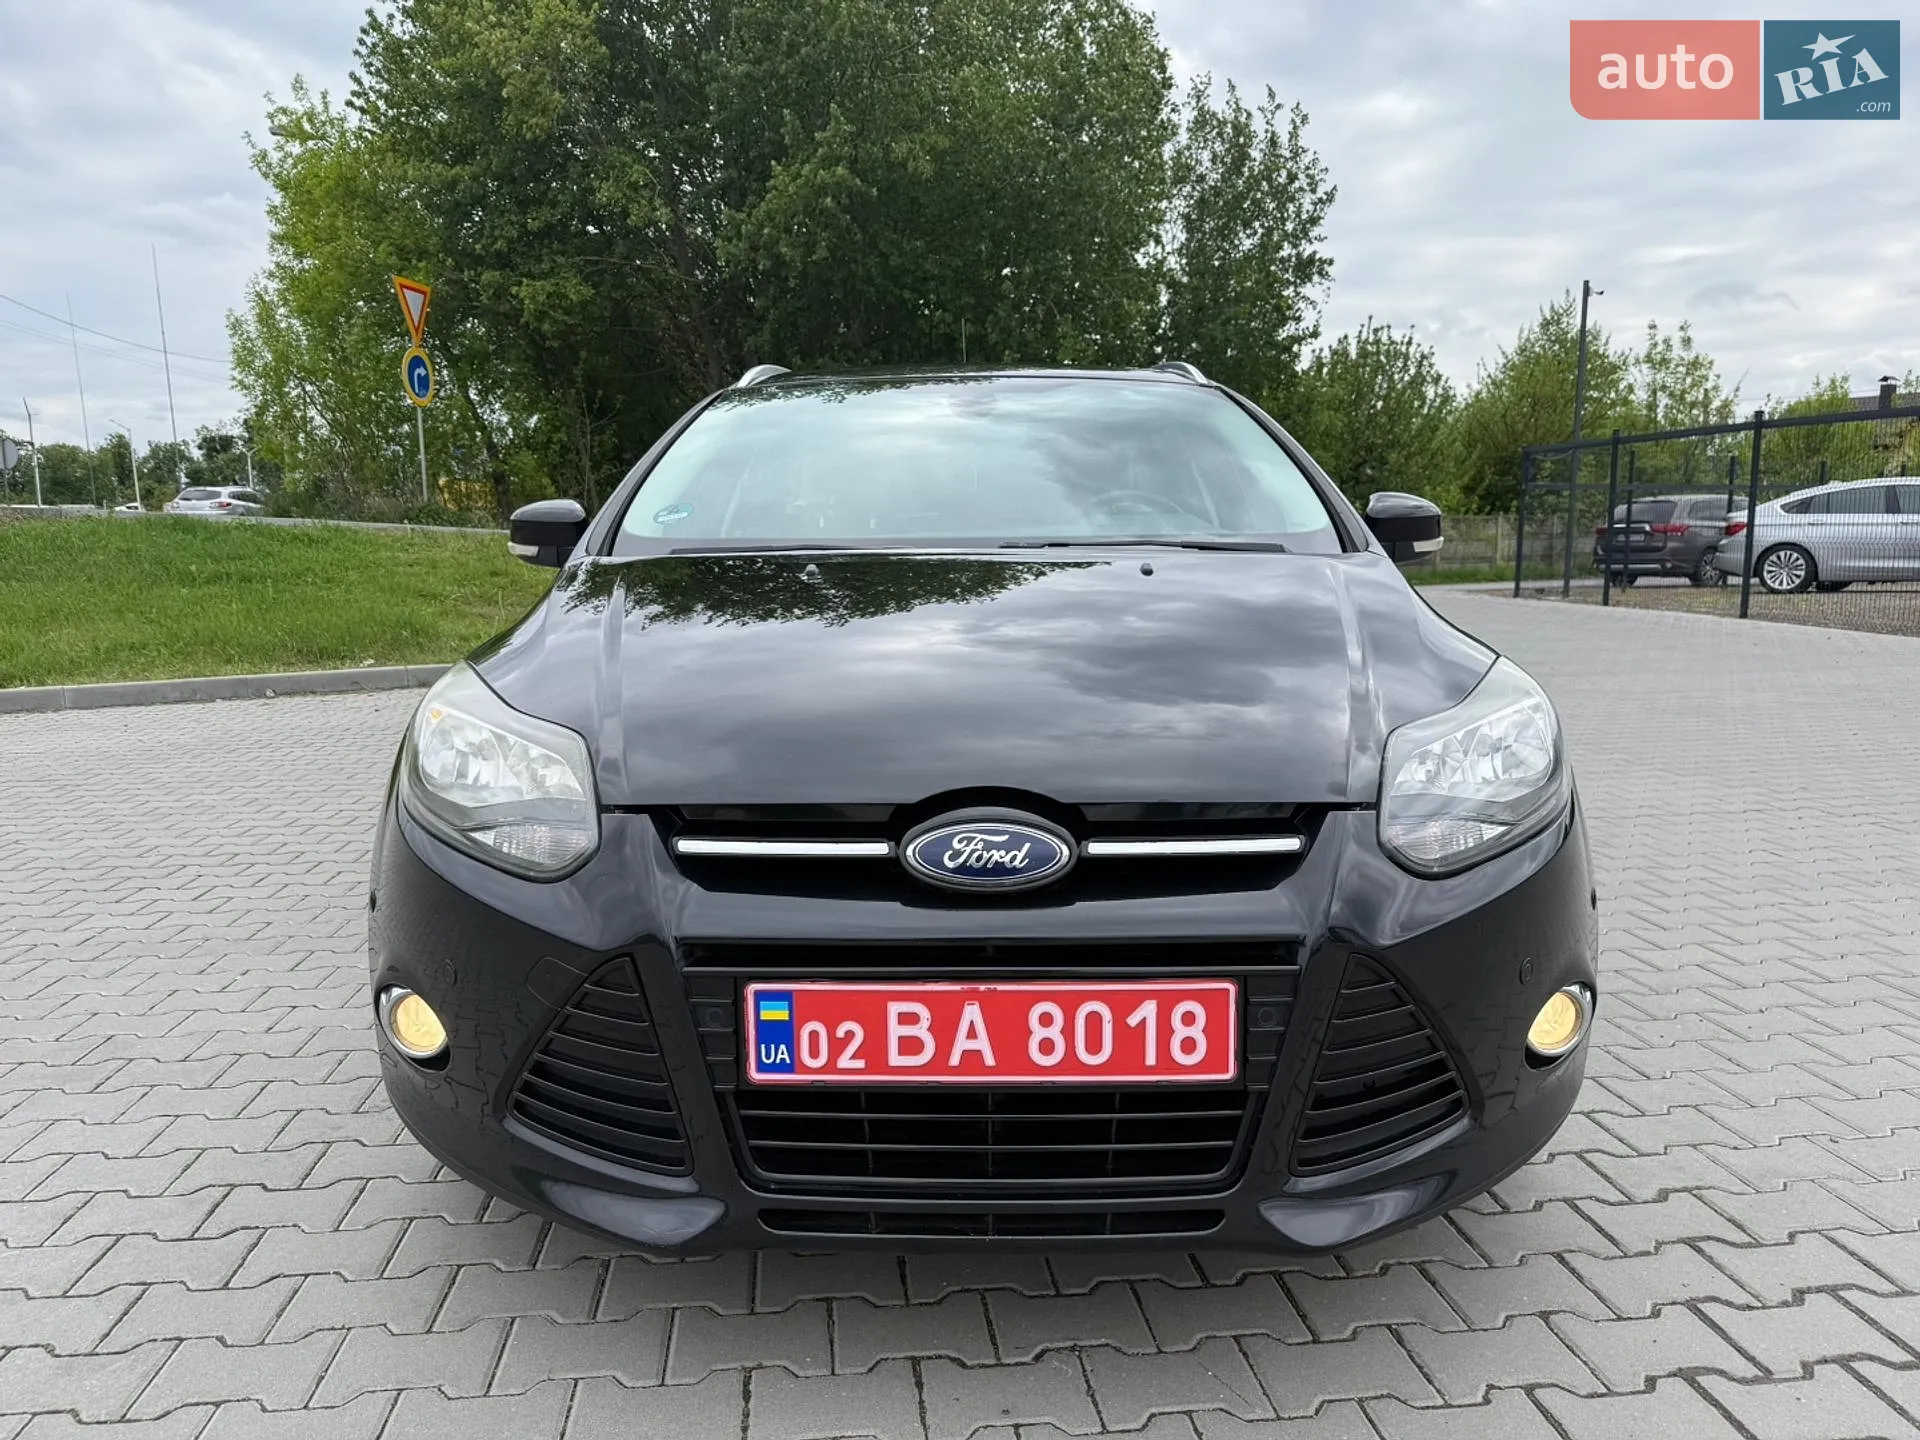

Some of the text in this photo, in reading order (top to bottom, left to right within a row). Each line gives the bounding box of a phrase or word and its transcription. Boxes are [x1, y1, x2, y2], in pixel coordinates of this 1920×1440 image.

[943, 833, 1031, 869] Ford
[800, 1000, 1208, 1069] 02 BA 8018
[760, 1043, 792, 1064] UA
